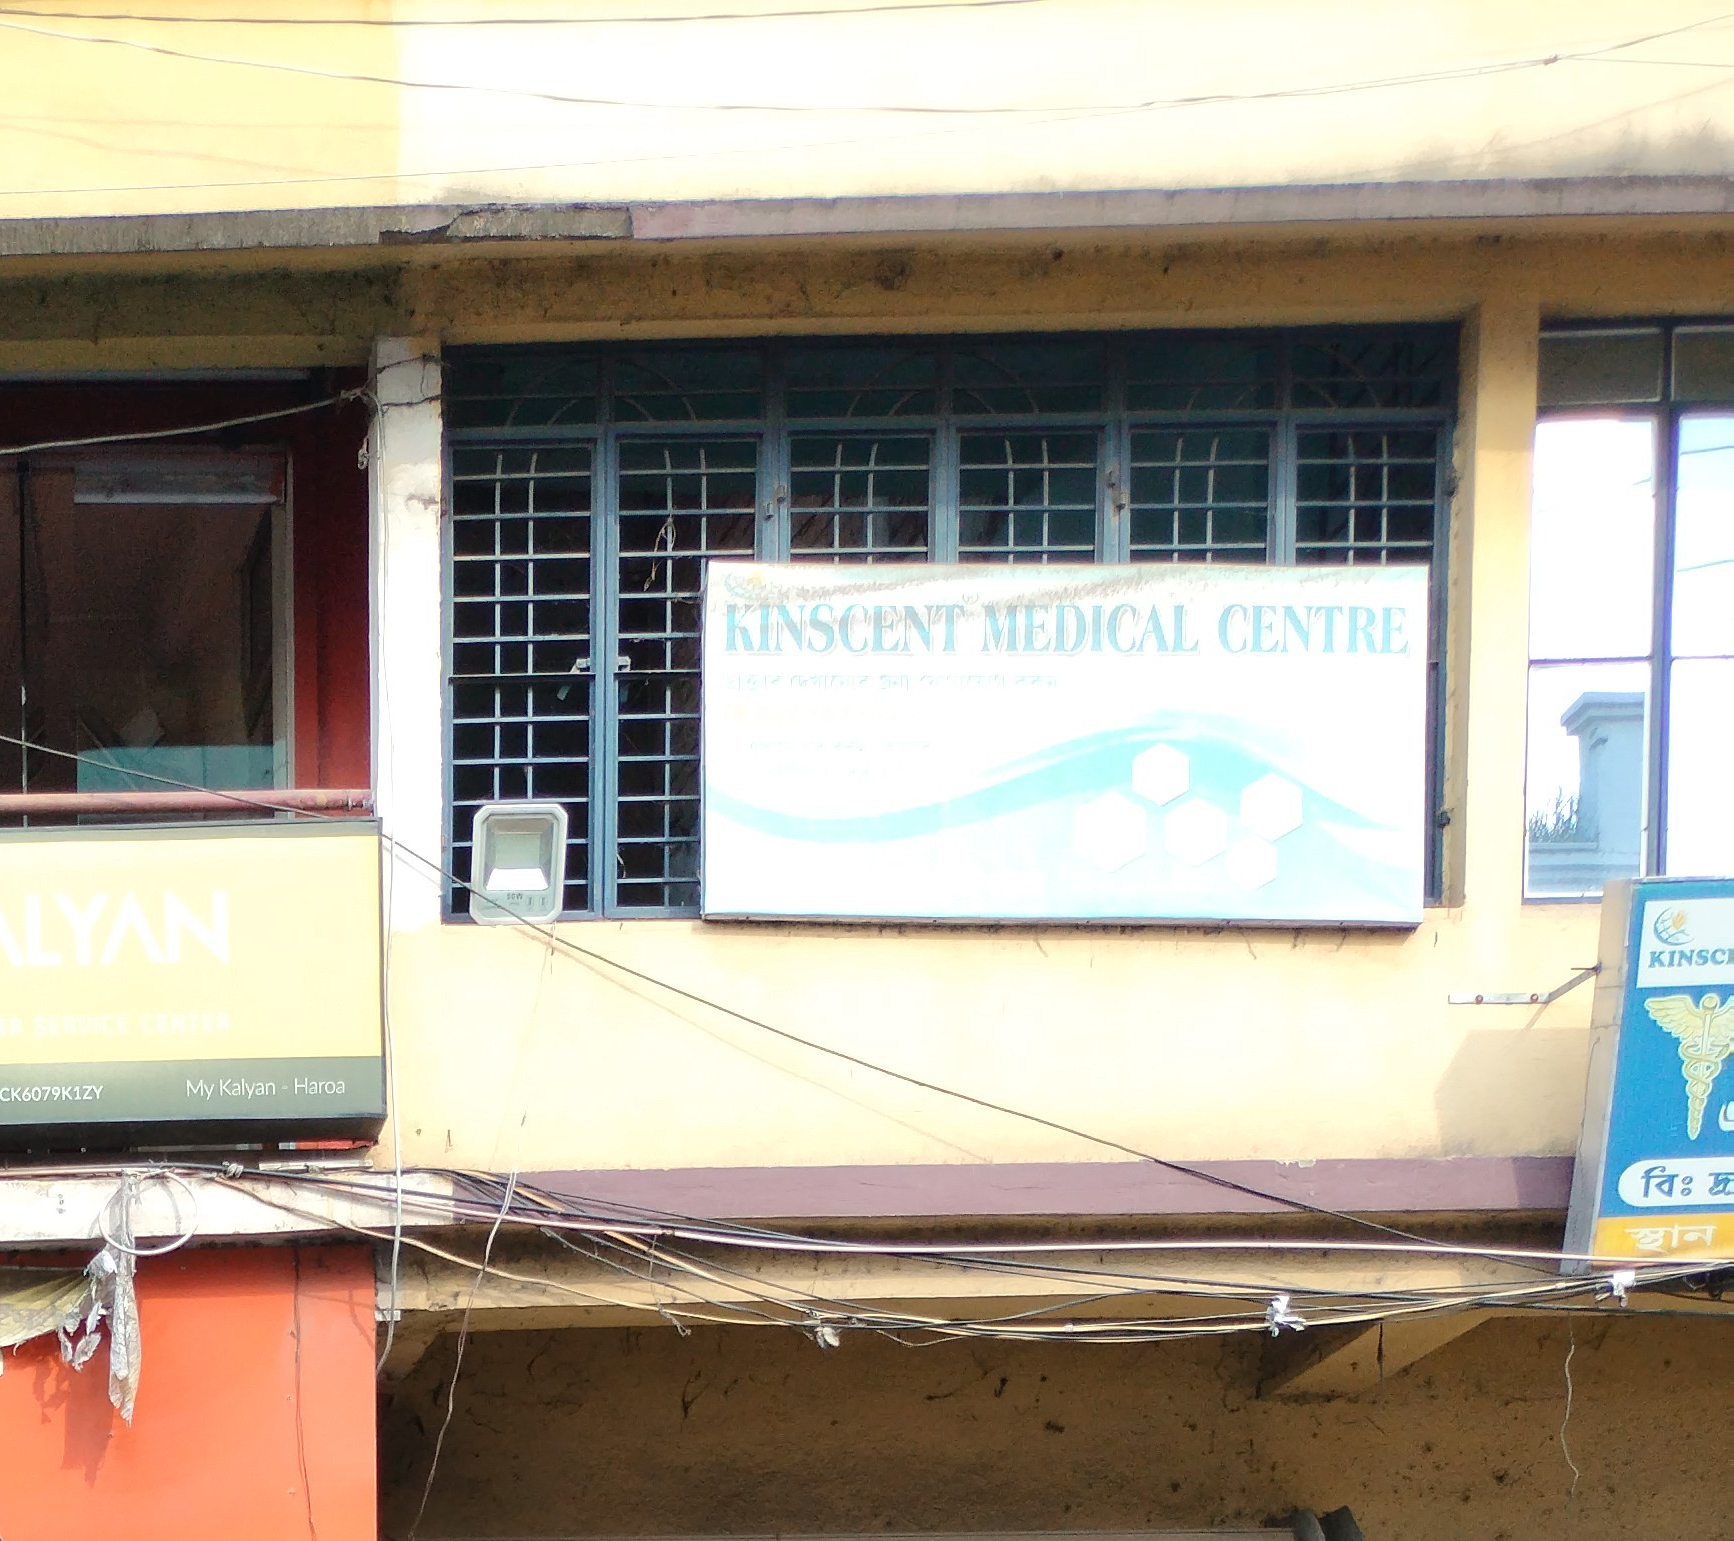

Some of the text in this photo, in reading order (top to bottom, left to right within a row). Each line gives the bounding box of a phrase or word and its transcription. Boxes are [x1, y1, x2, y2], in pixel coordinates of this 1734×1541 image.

[723, 603, 1411, 655] KINSCENT MEDICAL CENTRE
[185, 1078, 215, 1102] My
[219, 1077, 276, 1100] Kalyan
[294, 1076, 346, 1096] Haroa
